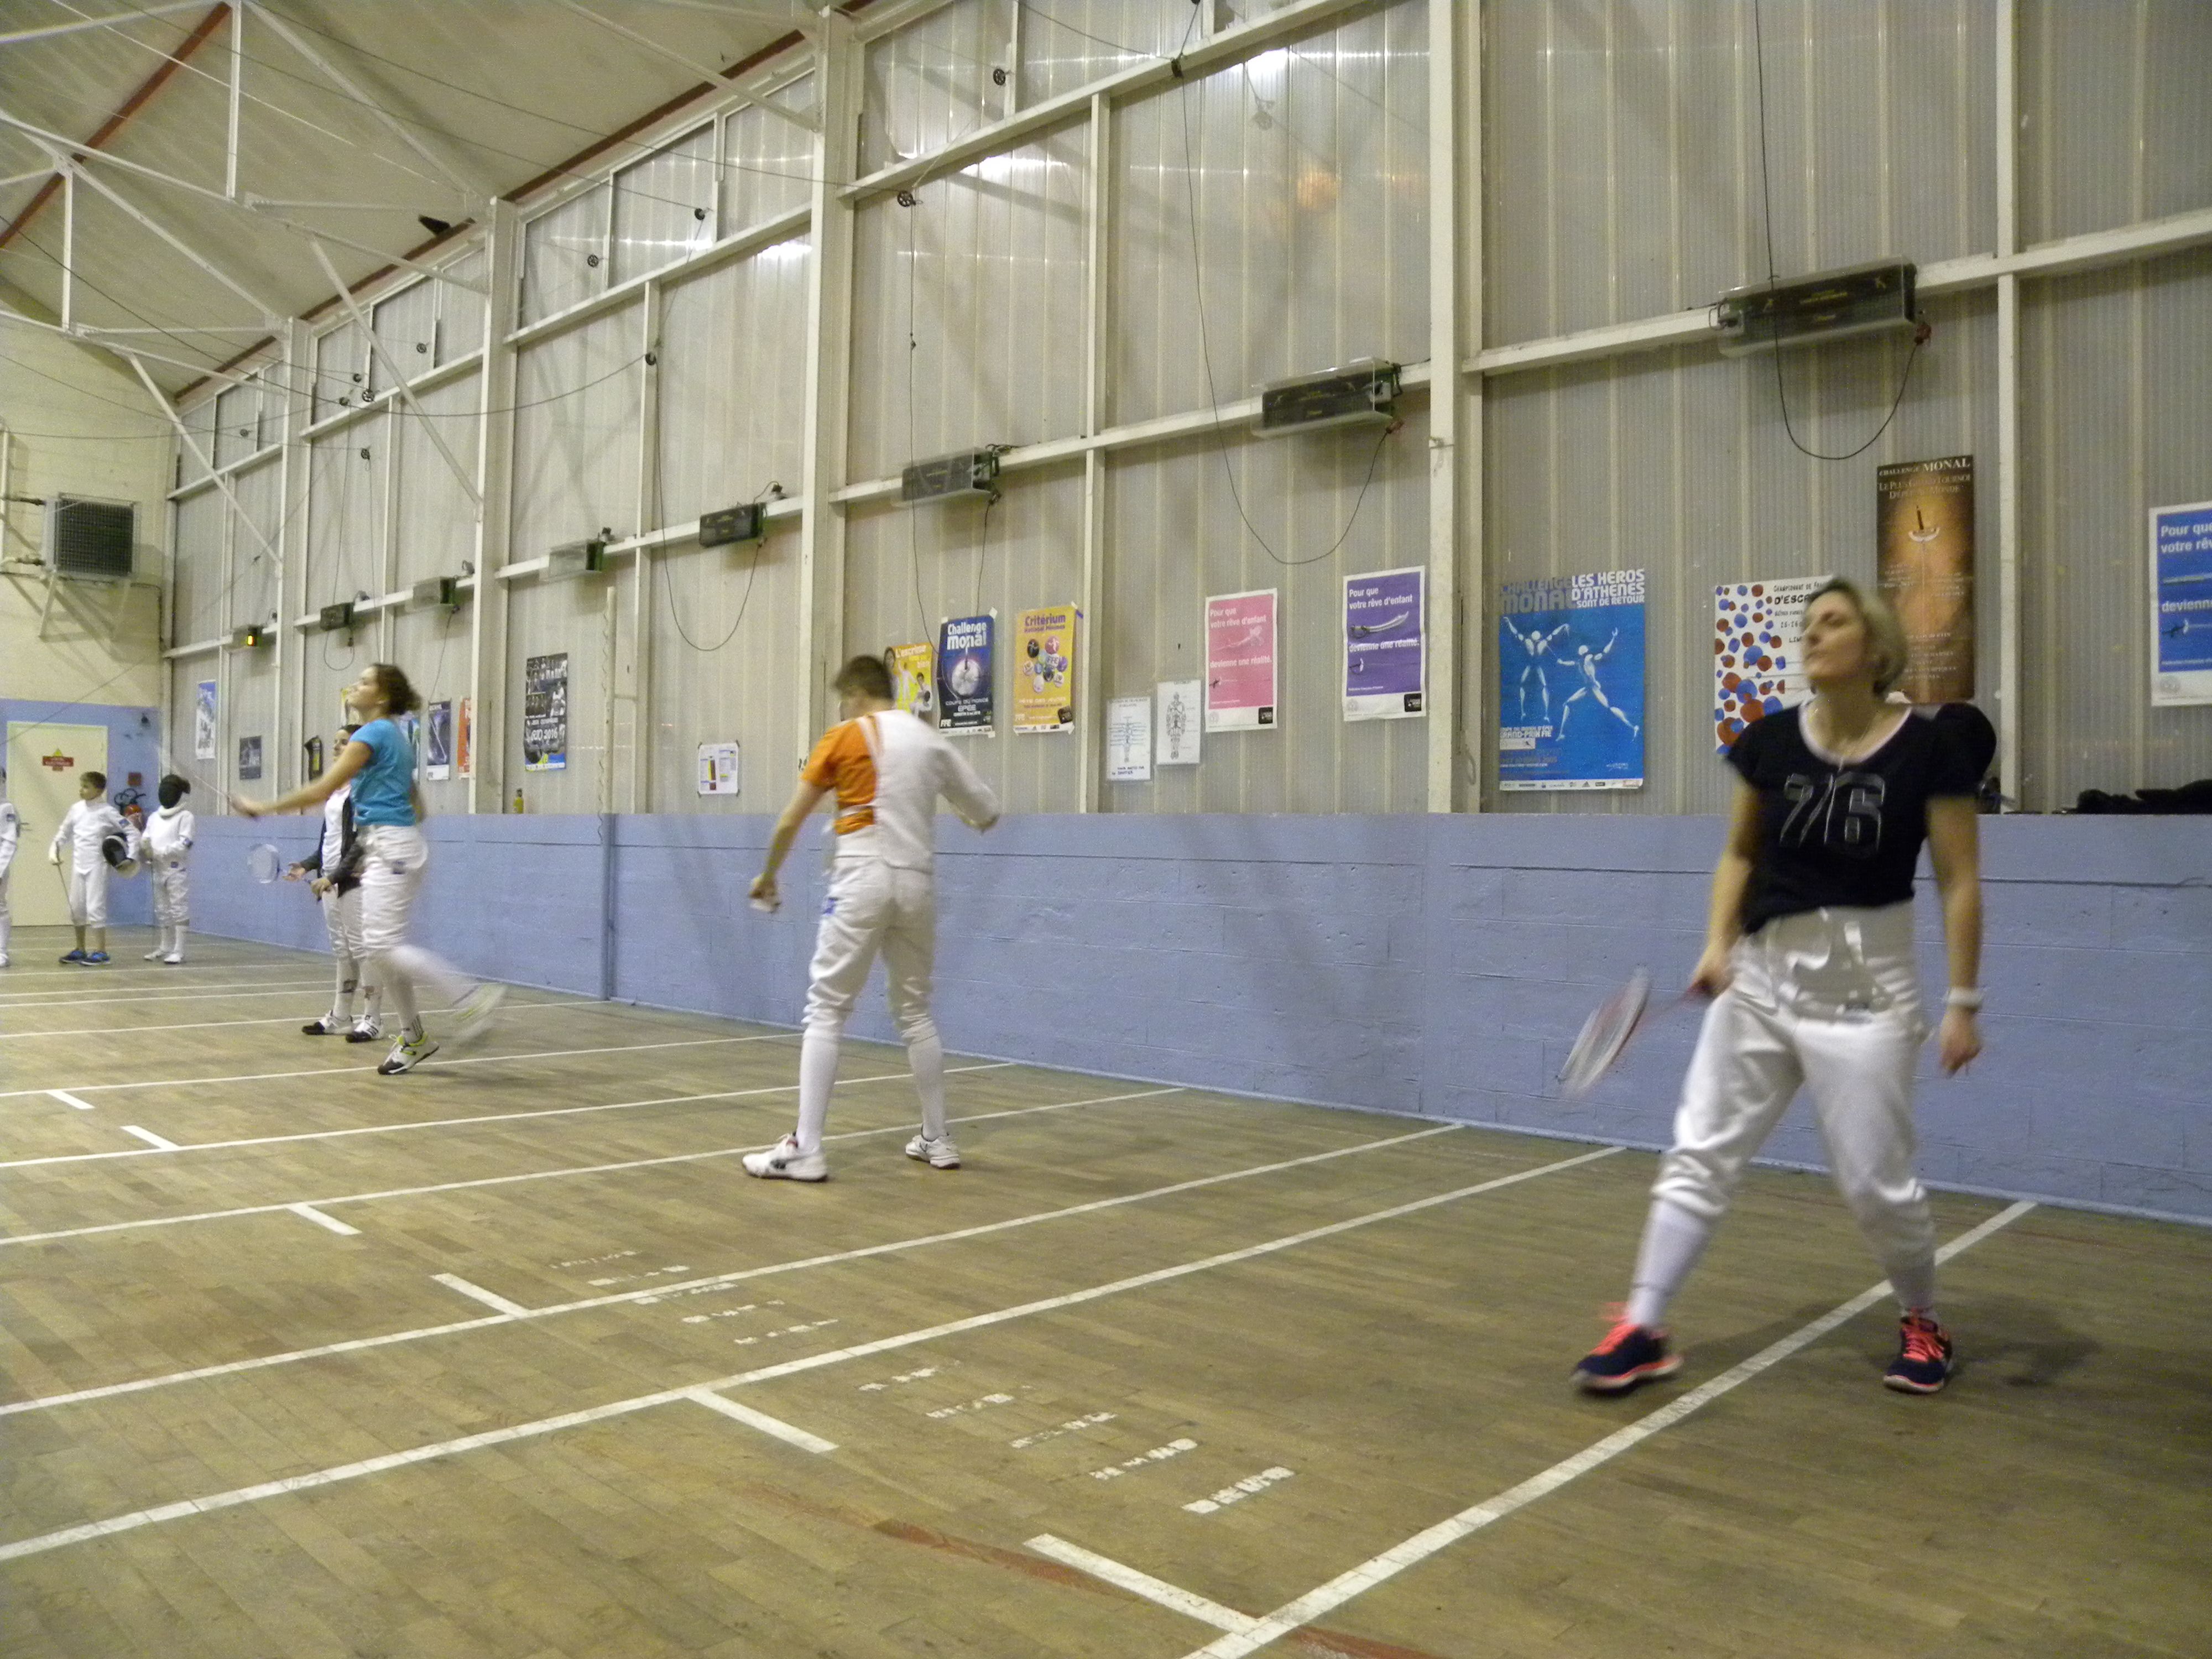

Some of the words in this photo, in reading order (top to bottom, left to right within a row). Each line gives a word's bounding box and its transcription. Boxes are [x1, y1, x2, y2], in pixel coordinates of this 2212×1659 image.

[1923, 458, 1971, 472] MONAL
[2161, 525, 2189, 537] Pour
[2161, 541, 2193, 553] votre
[1572, 573, 1595, 588] LES
[1598, 568, 1645, 586] HEROS
[1349, 589, 1364, 597] Pour
[1366, 587, 1379, 597] que
[1571, 582, 1645, 601] D'ATHENES
[1349, 601, 1366, 609] votre
[1368, 598, 1383, 608] rêve
[1384, 594, 1413, 606] d'enfant
[1577, 599, 1597, 608] SONT
[1599, 597, 1610, 606] DE
[1611, 594, 1645, 604] RETOUR
[1210, 609, 1224, 617] Pour
[1225, 608, 1237, 617] que
[1025, 613, 1066, 627] Critérium
[1210, 619, 1225, 628] votre
[1227, 618, 1240, 627] rêve
[1241, 614, 1266, 625] d'enfant
[947, 622, 987, 635] Challenge
[1349, 642, 1379, 653] devienne
[1380, 640, 1394, 650] une
